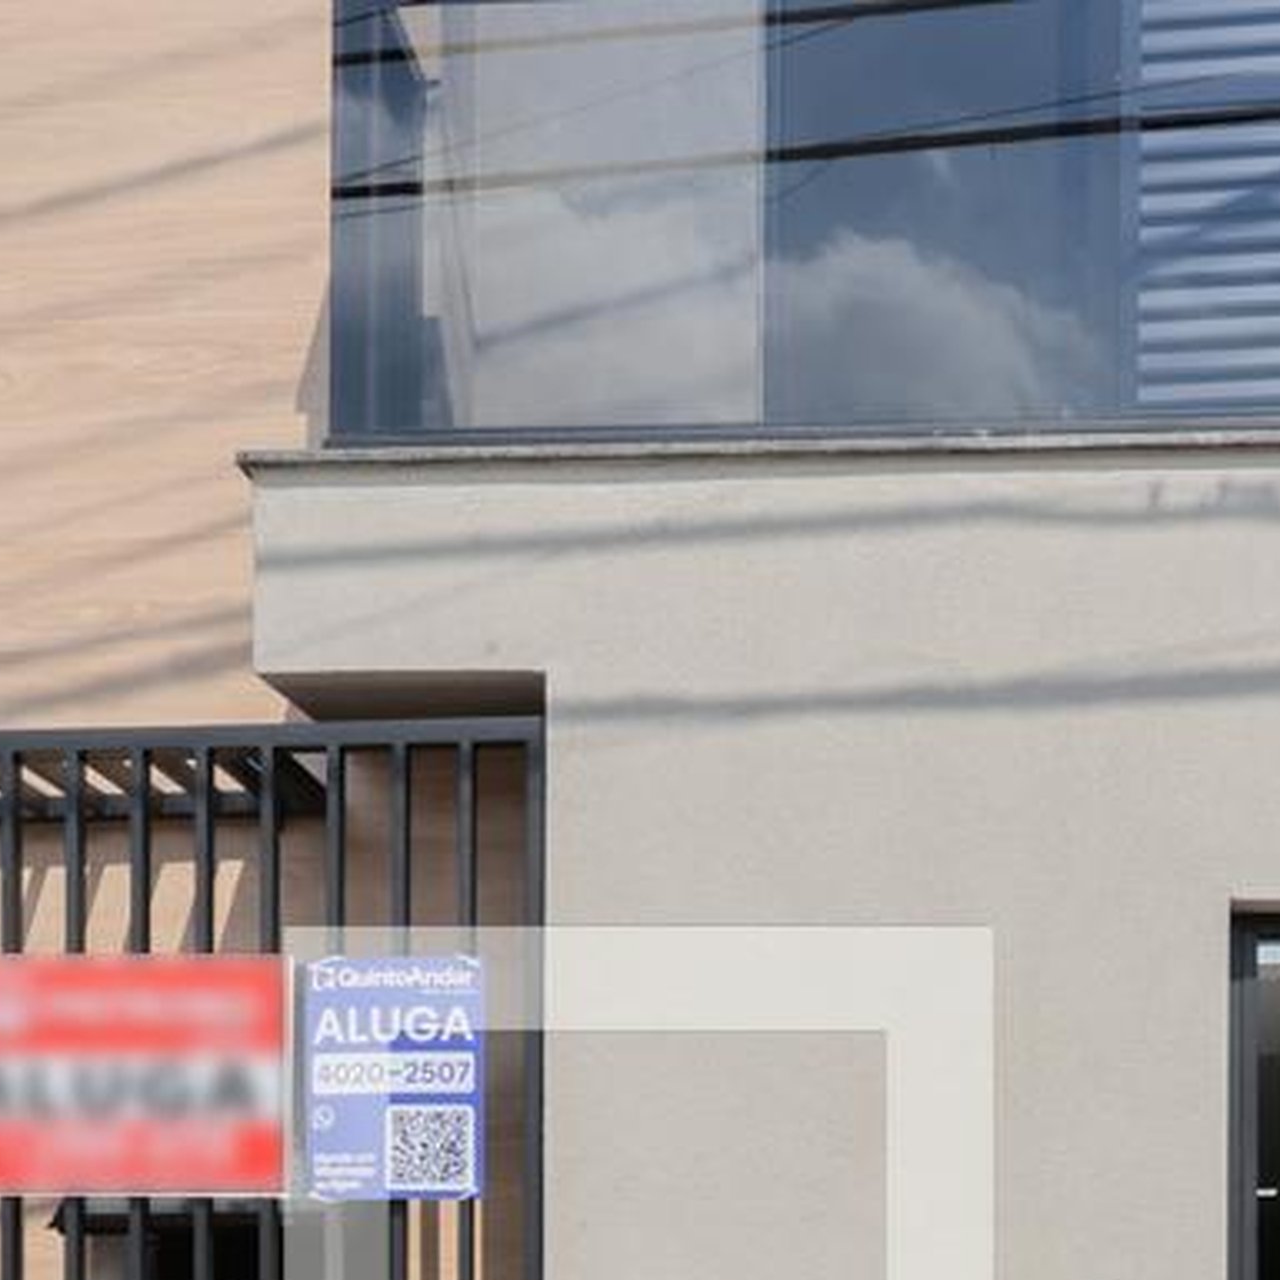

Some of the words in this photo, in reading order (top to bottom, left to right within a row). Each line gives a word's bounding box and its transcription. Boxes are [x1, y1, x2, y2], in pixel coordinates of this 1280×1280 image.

[337, 966, 473, 988] QuintoAndar
[314, 1006, 474, 1044] ALUGA
[320, 1061, 471, 1085] 4020-2507
